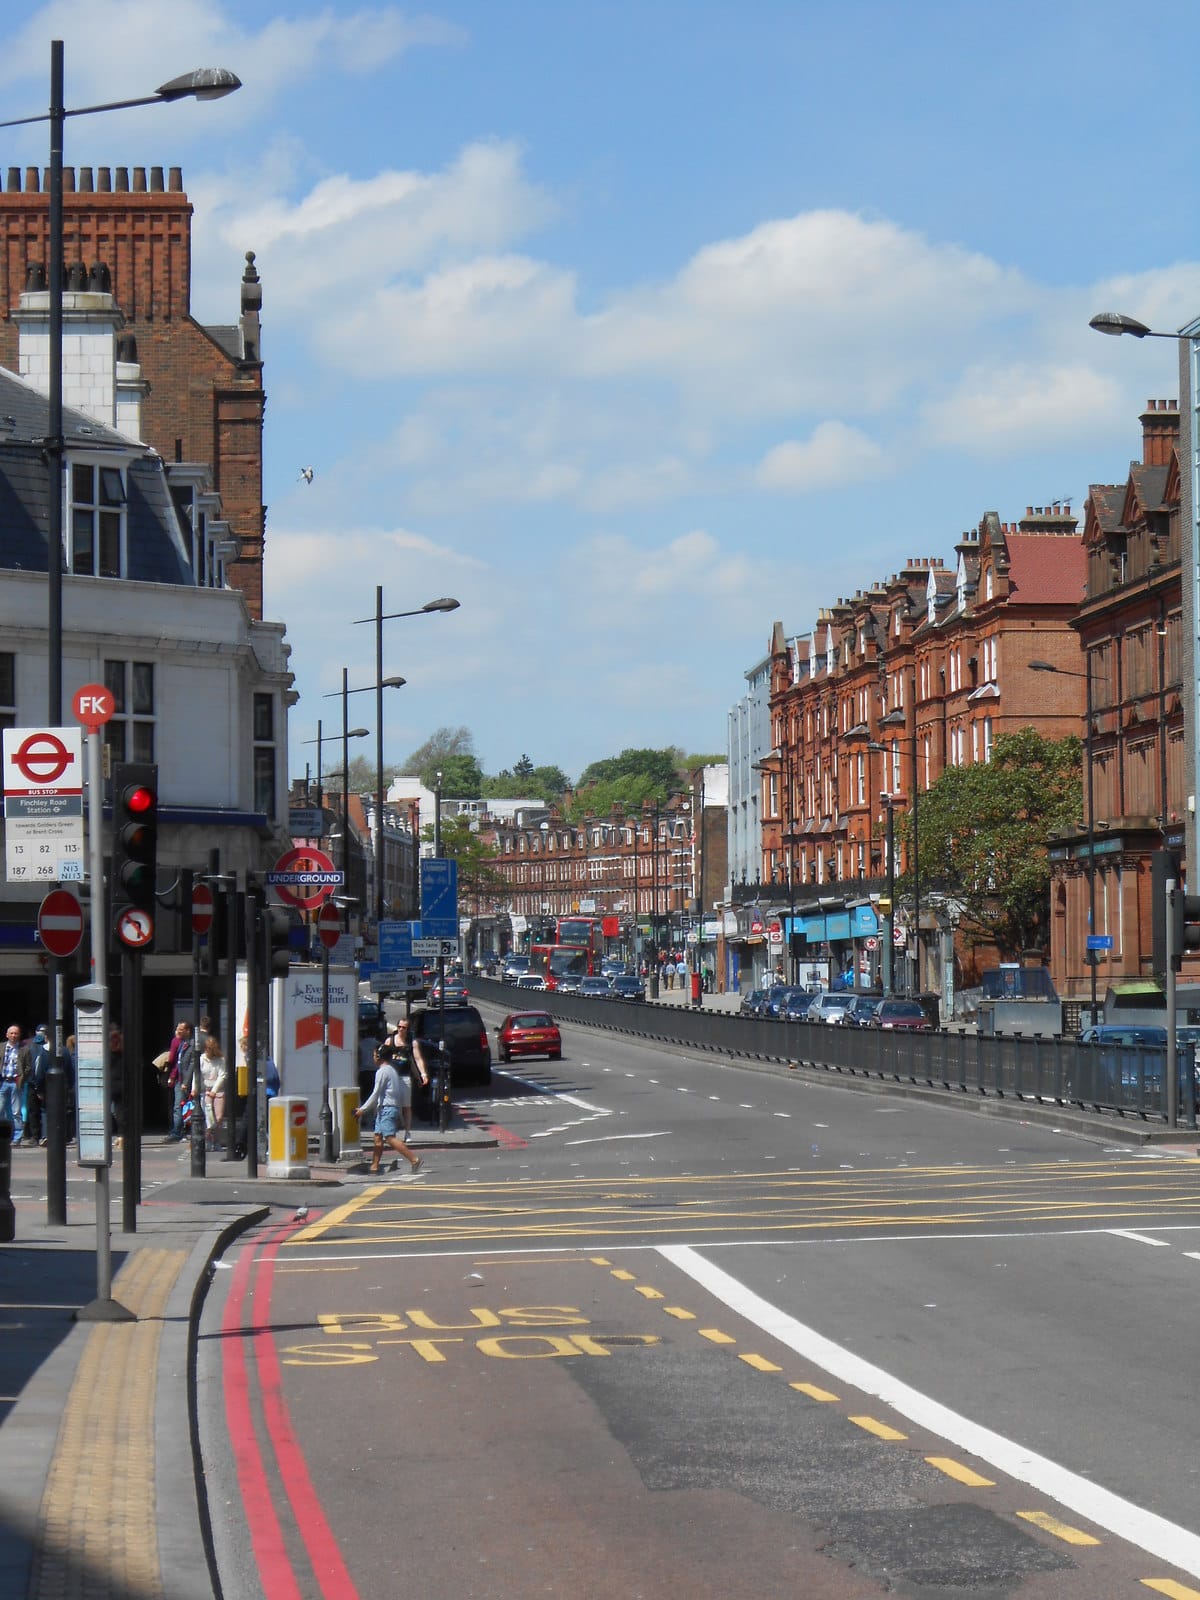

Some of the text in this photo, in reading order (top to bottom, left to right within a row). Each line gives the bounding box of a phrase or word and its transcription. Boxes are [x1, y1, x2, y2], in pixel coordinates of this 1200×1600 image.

[79, 696, 107, 715] FK
[15, 845, 24, 854] 13
[39, 845, 50, 853] 82
[64, 844, 77, 852] 113
[12, 867, 26, 875] 187
[37, 866, 54, 875] 268
[268, 873, 340, 883] UNDERGROUND
[305, 984, 344, 995] Eveing
[304, 995, 348, 1003] Stadard
[316, 1306, 591, 1334] BUS
[282, 1335, 661, 1365] STOP
